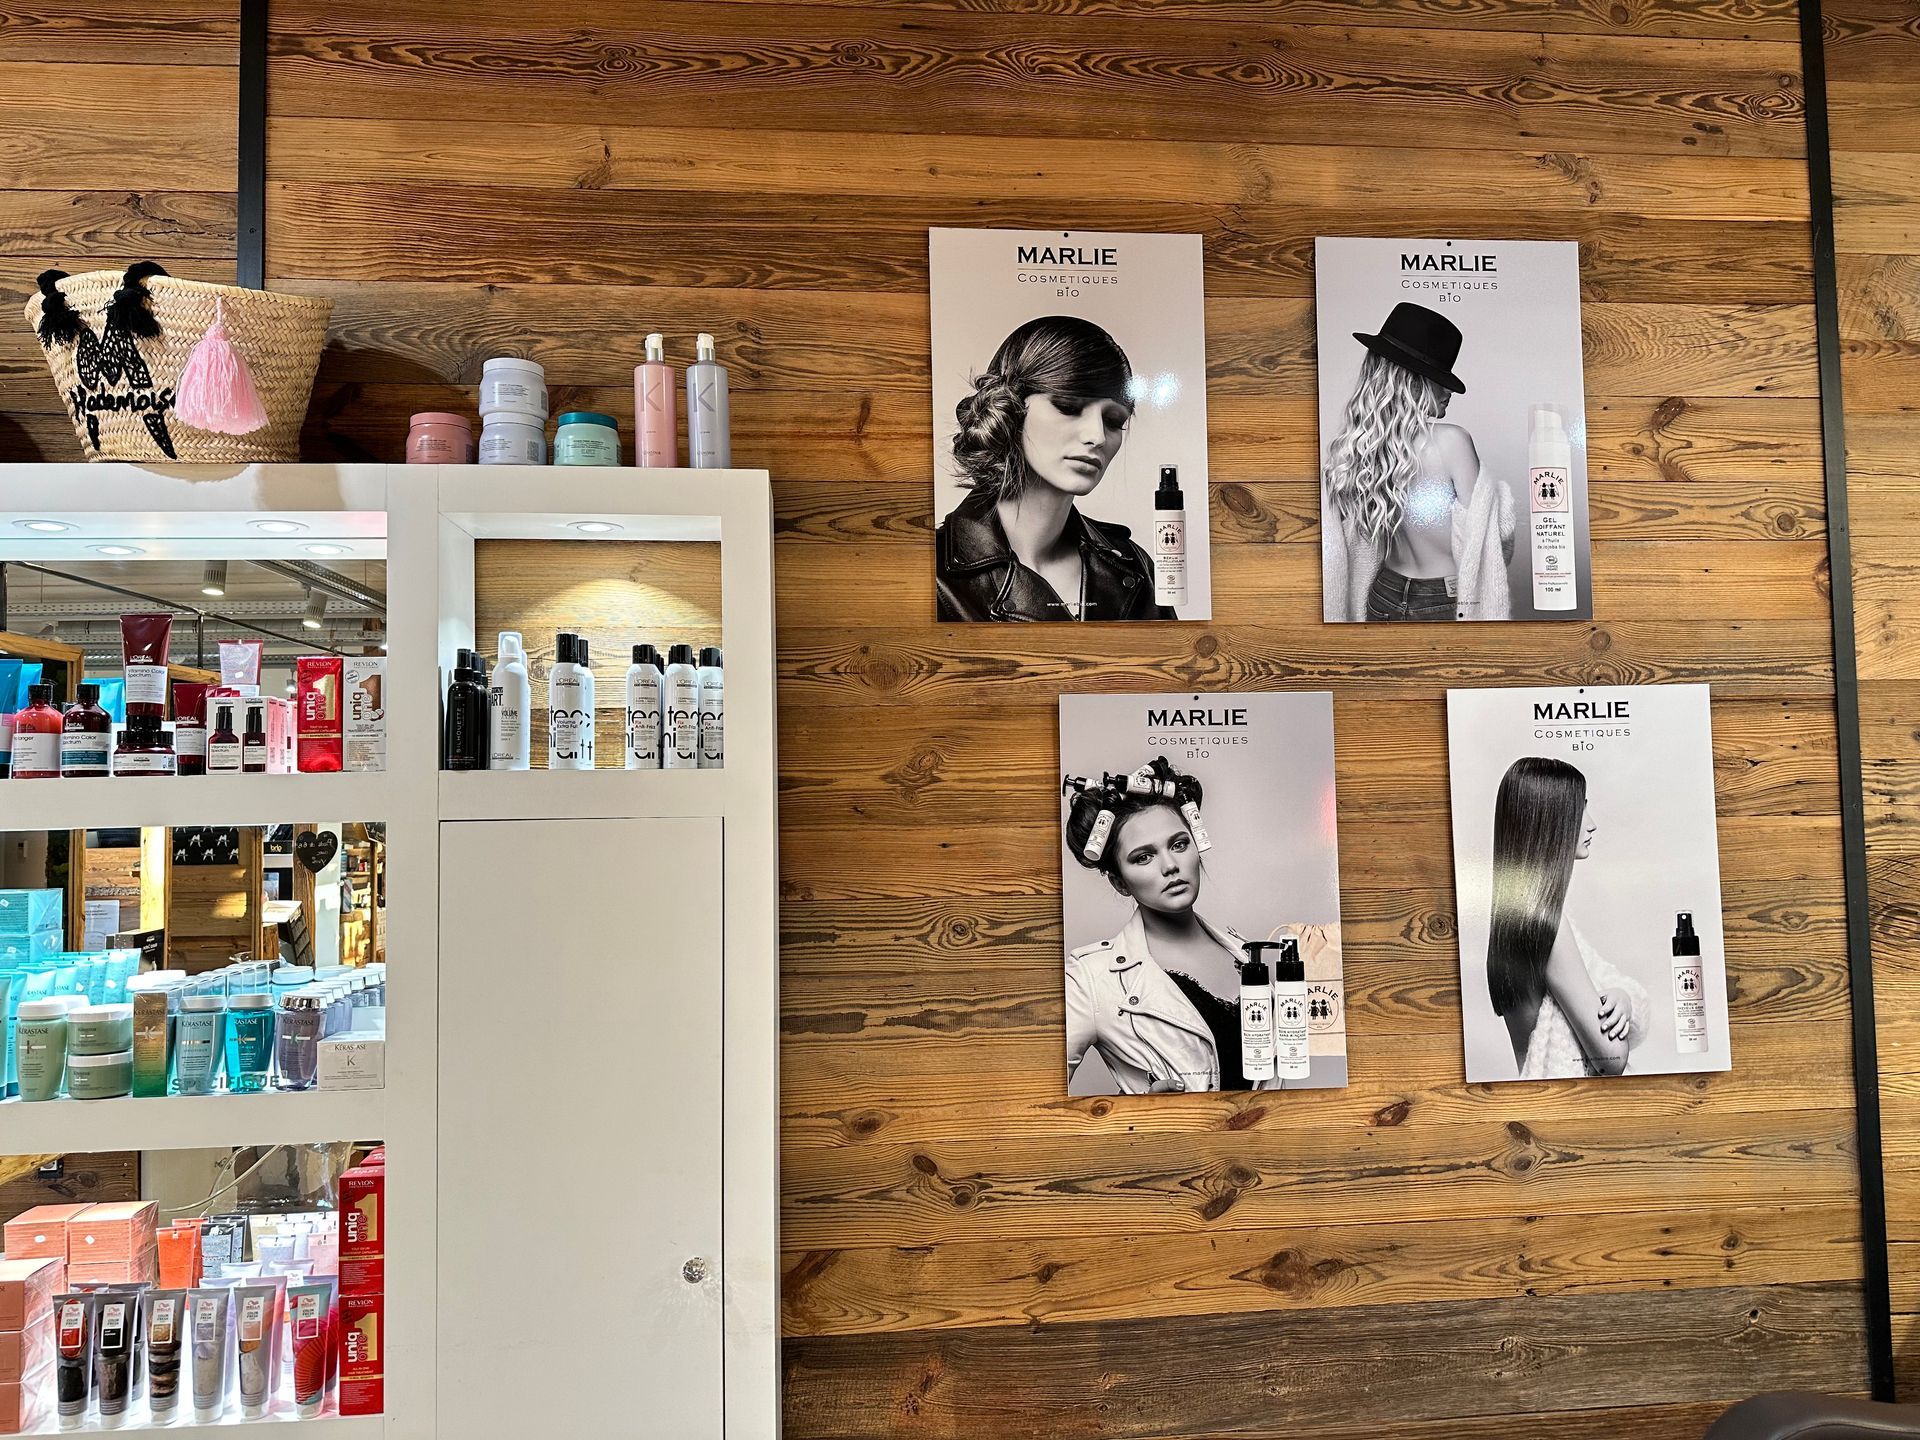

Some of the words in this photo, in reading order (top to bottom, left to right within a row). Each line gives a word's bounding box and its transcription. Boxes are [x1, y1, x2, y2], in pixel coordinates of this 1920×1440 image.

[1017, 246, 1118, 266] MARLIE
[1400, 254, 1497, 272] MARLIE
[1017, 273, 1118, 285] COSMETIQUES
[1401, 280, 1498, 290] COSMETIQUES
[70, 382, 175, 424] Mademois
[1533, 471, 1565, 485] MARLIE
[1158, 523, 1182, 535] MARLIE
[1533, 701, 1630, 720] MARLIE
[1147, 709, 1248, 726] MARLIE
[1534, 728, 1631, 739] COSMETIQUES
[1148, 736, 1249, 745] COSMETIQUES
[1677, 969, 1700, 981] MARLIE
[1307, 986, 1339, 1001] ARLIE
[1245, 1002, 1268, 1011] MARLIE
[1280, 998, 1304, 1008] MARLIE
